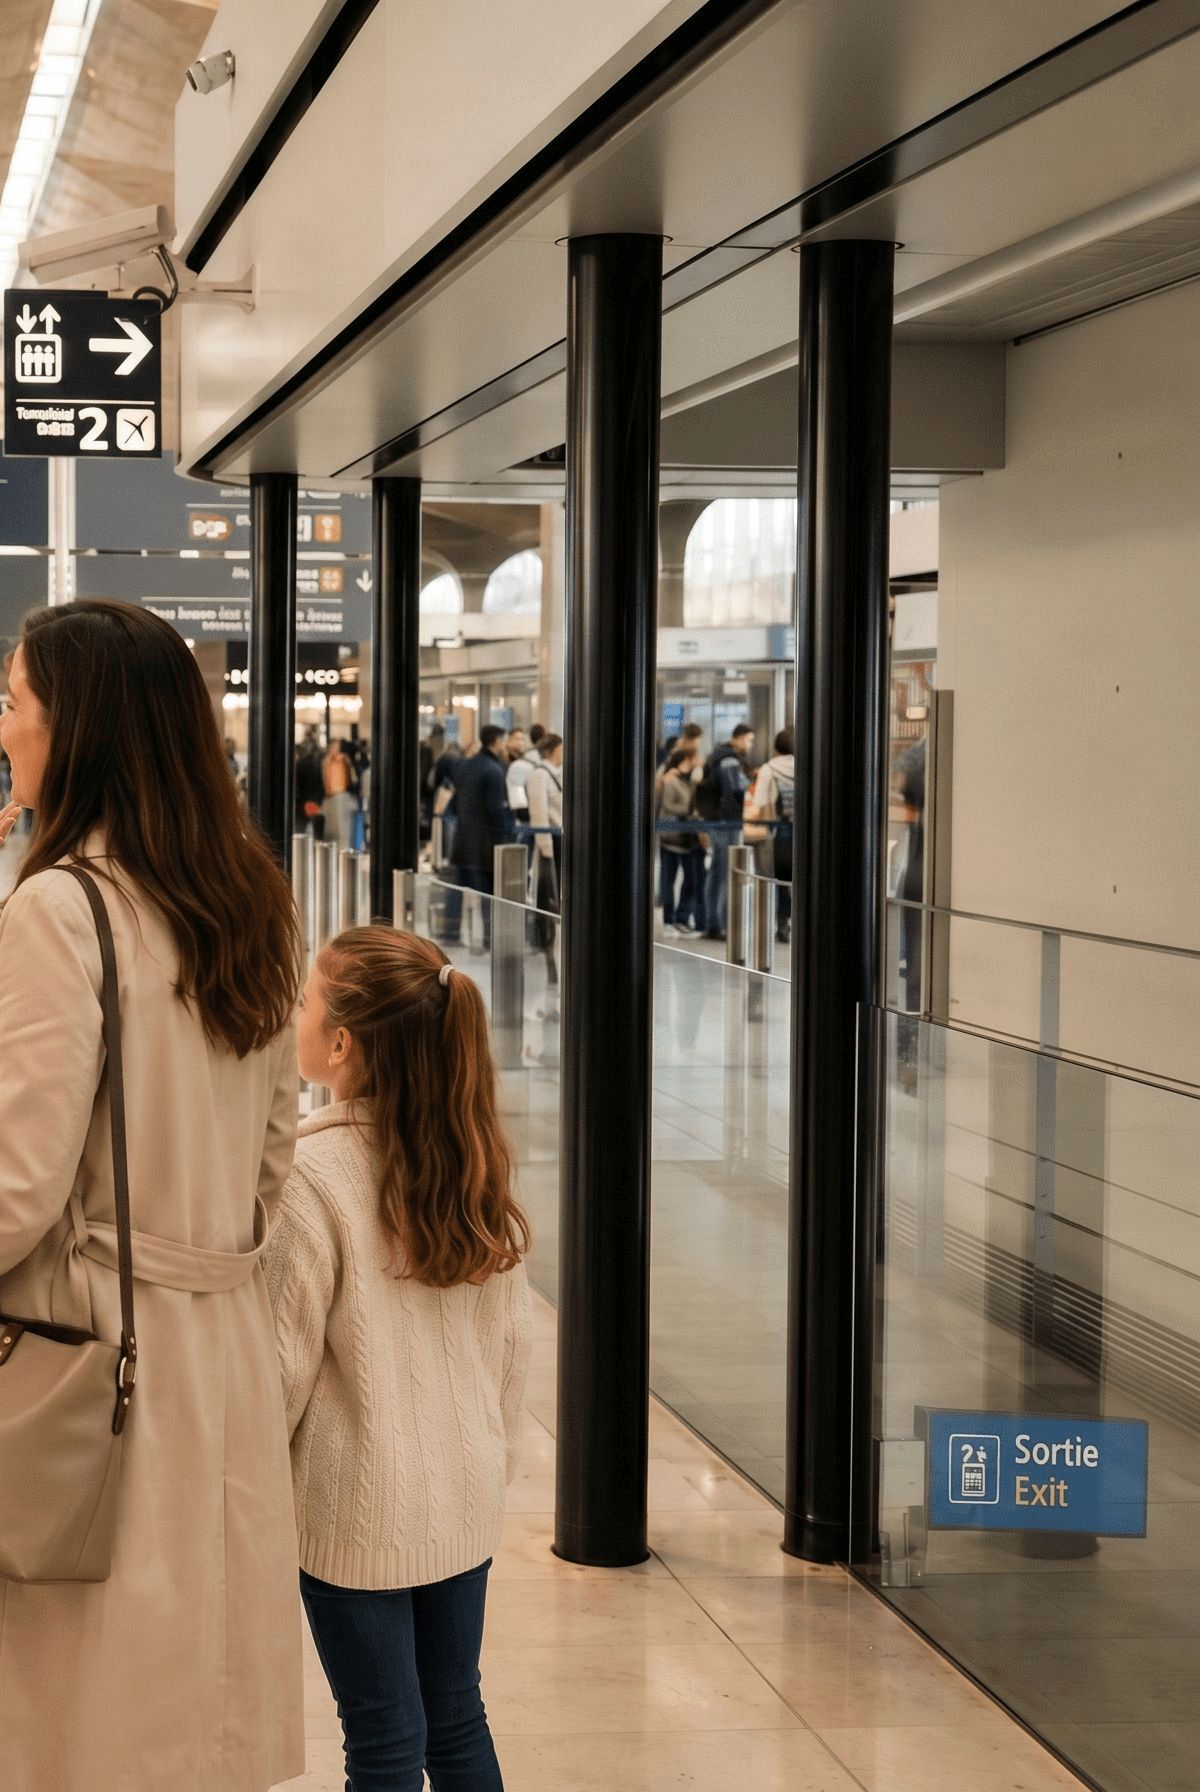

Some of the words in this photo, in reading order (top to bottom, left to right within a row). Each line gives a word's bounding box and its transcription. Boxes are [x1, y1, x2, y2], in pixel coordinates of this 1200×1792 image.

[78, 406, 109, 451] 2
[1015, 1434, 1099, 1468] Sortie
[1015, 1475, 1069, 1507] Exit
